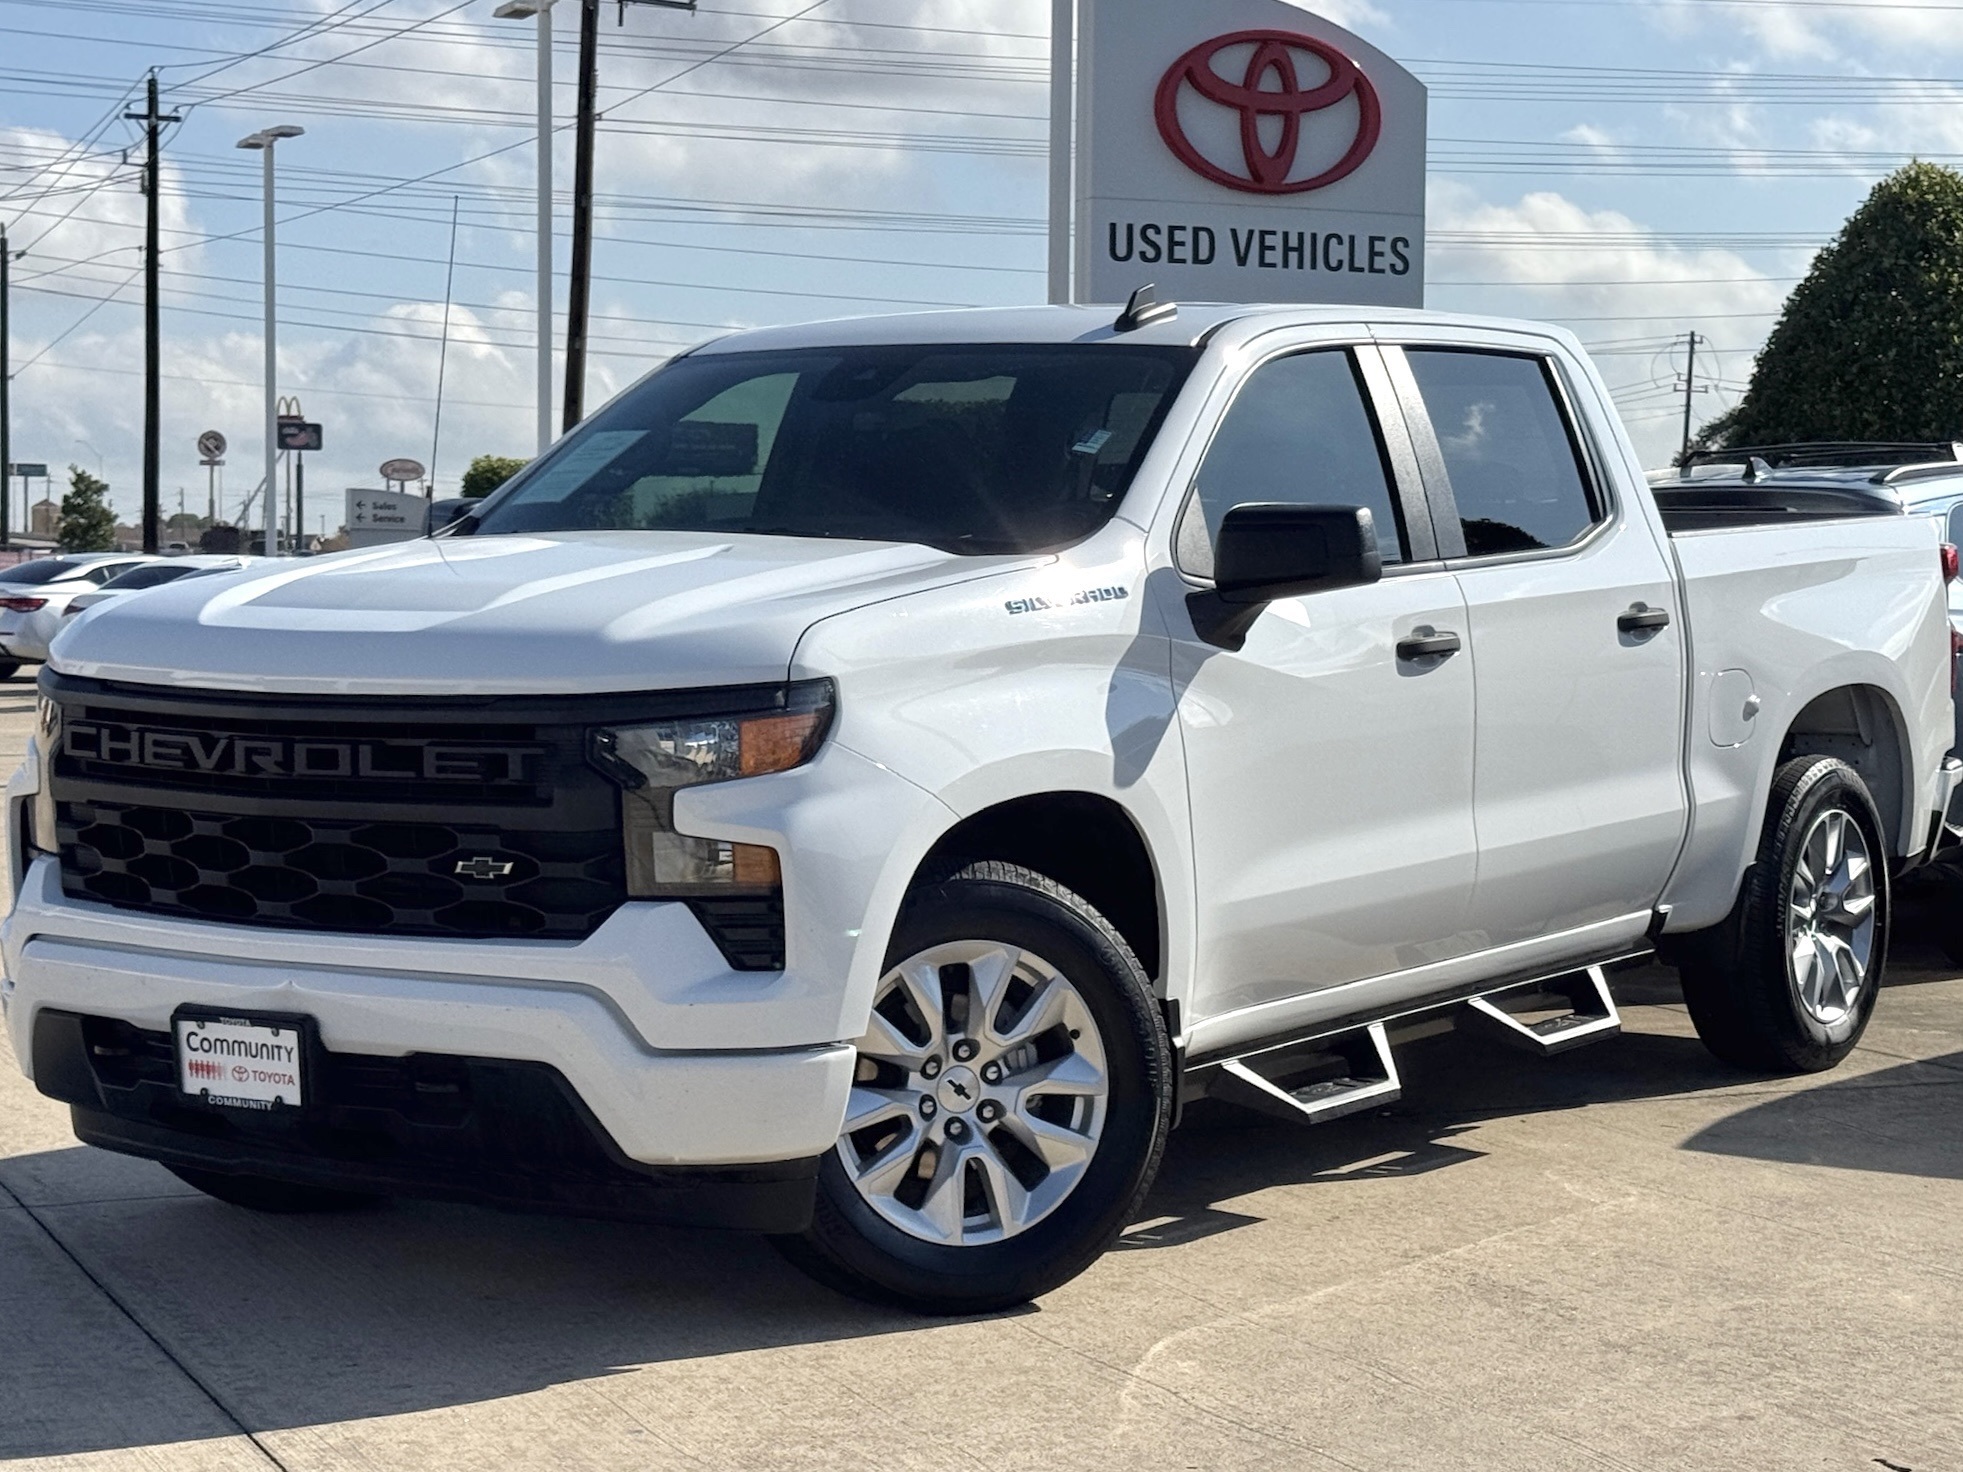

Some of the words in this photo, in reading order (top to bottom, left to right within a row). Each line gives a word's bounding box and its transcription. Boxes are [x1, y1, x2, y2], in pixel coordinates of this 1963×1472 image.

[1108, 222, 1216, 265] USED
[1229, 228, 1410, 276] VEHICLES
[372, 502, 397, 510] Sales
[372, 513, 405, 523] Service
[1004, 586, 1129, 615] SILVRADO
[63, 724, 546, 780] CHEVROLET
[251, 1069, 296, 1086] TOYOTA
[207, 1095, 274, 1111] COMMUNITY
